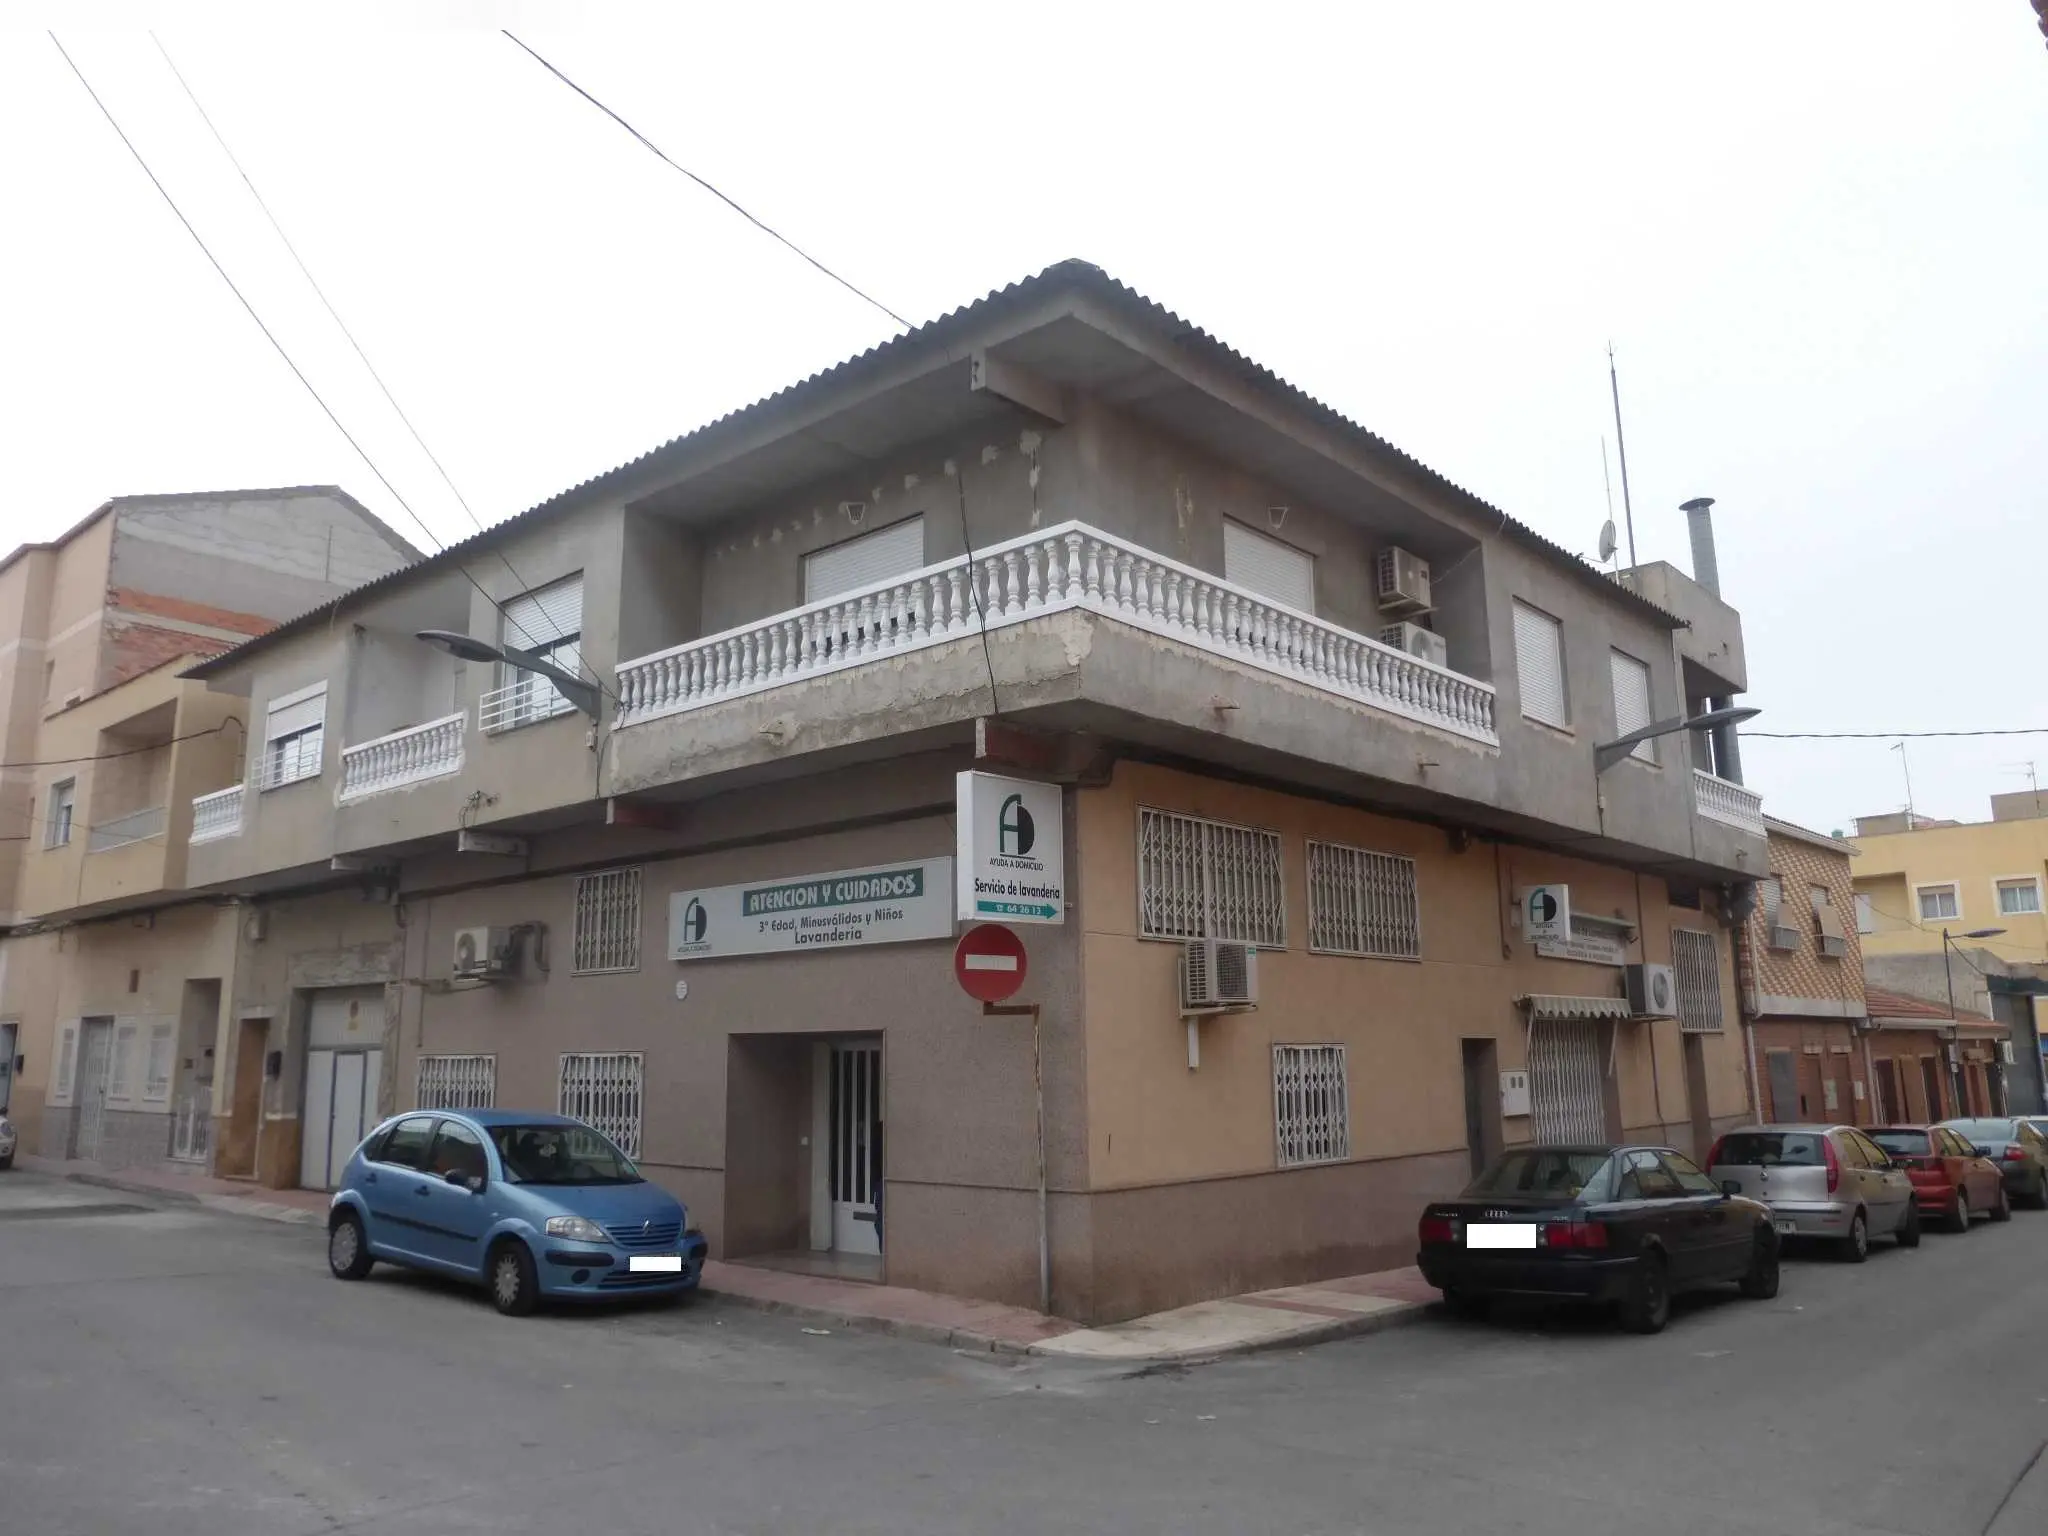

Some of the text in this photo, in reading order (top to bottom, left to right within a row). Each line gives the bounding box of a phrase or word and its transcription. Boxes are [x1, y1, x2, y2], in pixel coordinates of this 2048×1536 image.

[990, 857, 1044, 871] AYUDA A DOMICILIO
[750, 873, 916, 912] ATENCION Y CUIDADOS
[974, 877, 1006, 894] Servicio
[1008, 880, 1017, 896] de
[772, 918, 797, 931] Edad,
[800, 912, 863, 929] Minusválidos
[866, 914, 871, 925] y
[875, 908, 904, 921] Niños
[794, 926, 863, 945] Lavandería
